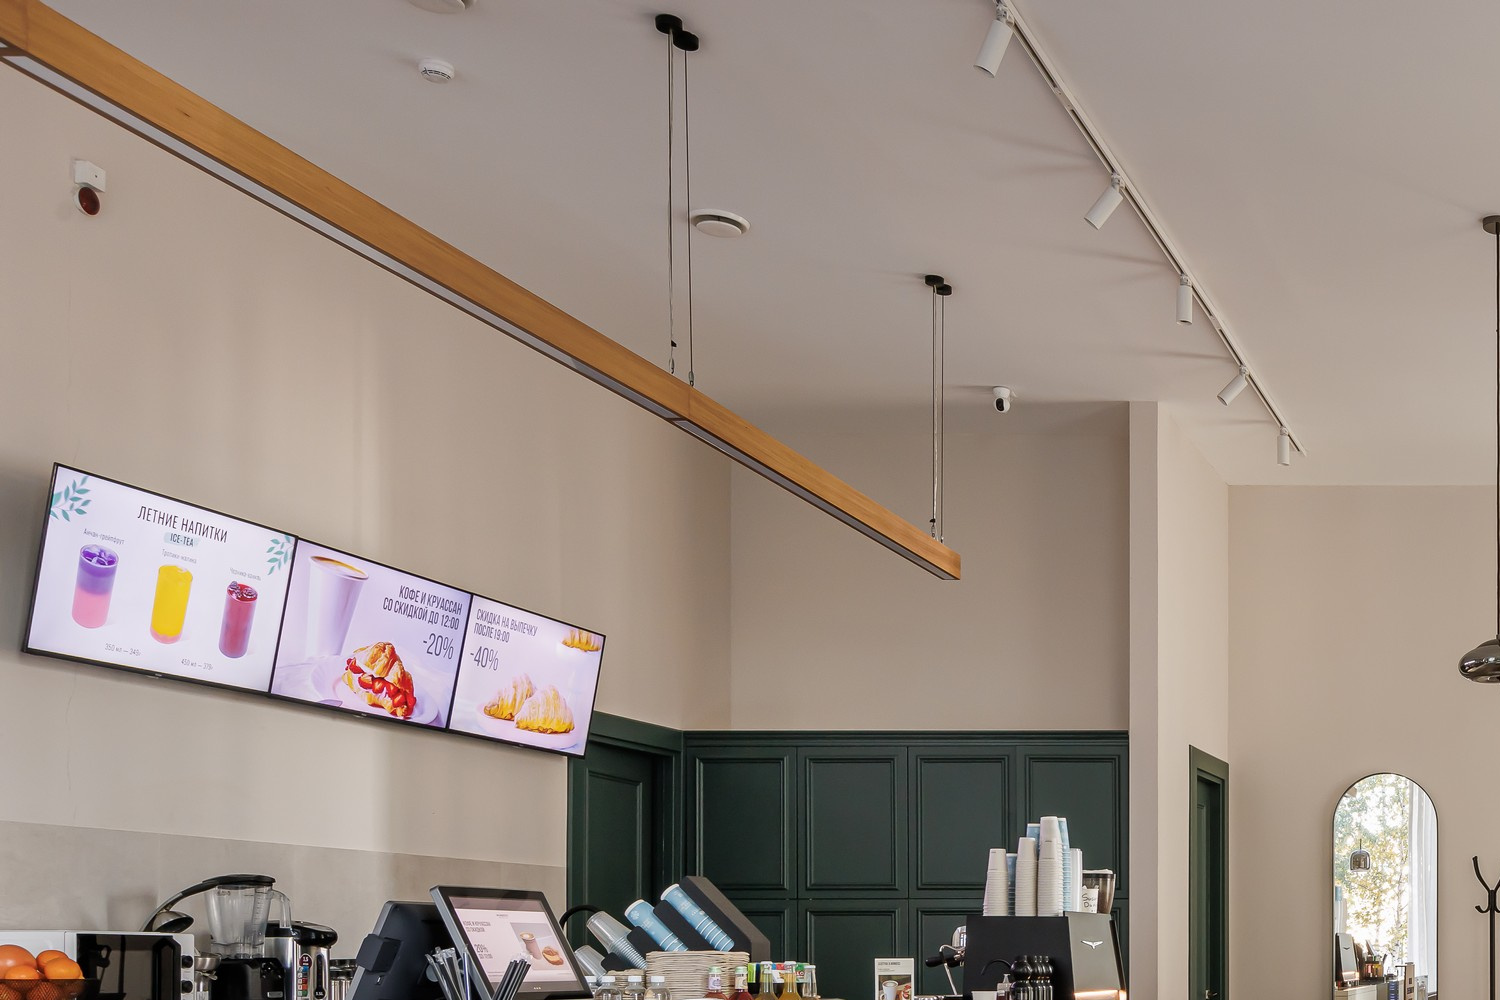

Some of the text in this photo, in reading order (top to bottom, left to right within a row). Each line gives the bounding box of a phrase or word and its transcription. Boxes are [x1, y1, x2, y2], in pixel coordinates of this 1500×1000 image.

[138, 506, 228, 544] ЛЕТНИЕ НАПИТКИ
[170, 533, 194, 547] ICE-TEA
[383, 597, 460, 630] СО СКИДКОЙ ДО 12:00
[399, 585, 463, 616] КОФЕ И КРУАССАН
[474, 622, 510, 643] ПОСЛЕ 19:00
[476, 608, 539, 637] СКИДКА НА ВЫПЕЧКУ
[423, 633, 454, 660] -20%
[470, 646, 499, 671] -40%
